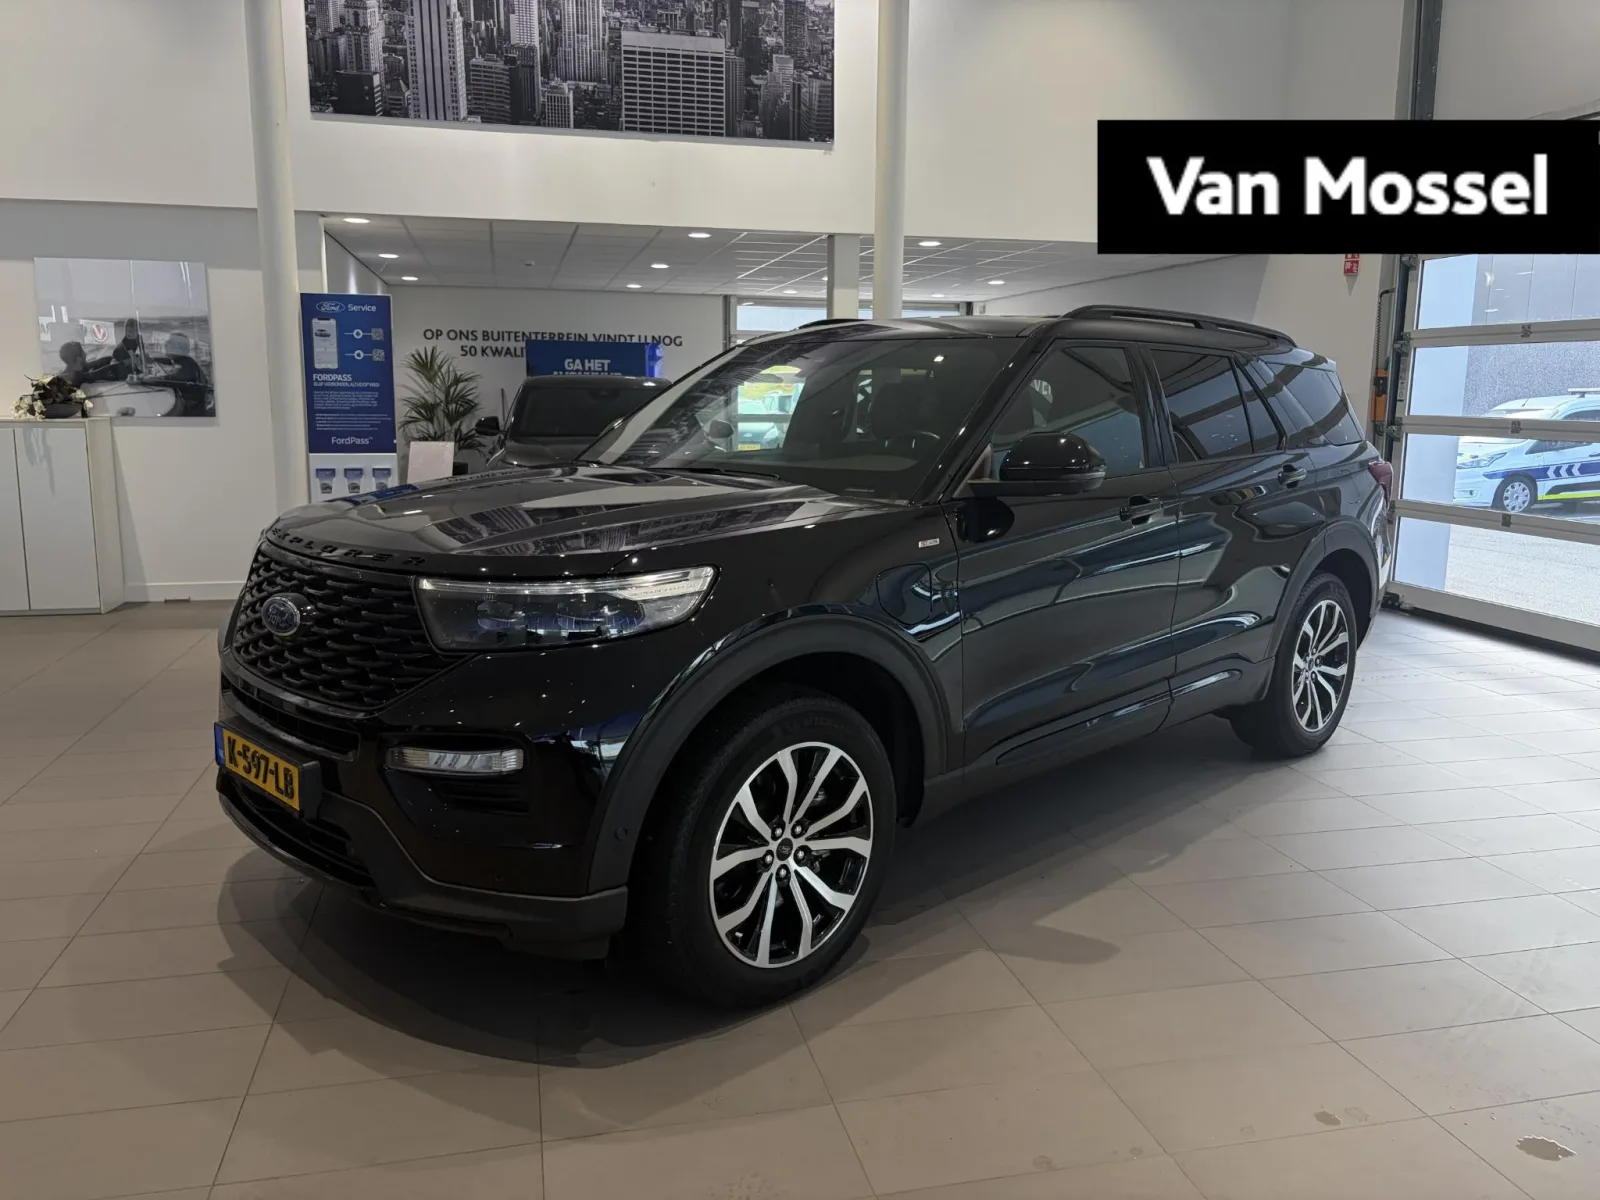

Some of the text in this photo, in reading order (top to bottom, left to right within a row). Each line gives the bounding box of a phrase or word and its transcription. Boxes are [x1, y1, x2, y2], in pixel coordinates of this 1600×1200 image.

[347, 303, 377, 312] Service
[423, 328, 443, 340] OP
[446, 329, 478, 341] ONS
[650, 335, 683, 347] NOG
[460, 345, 526, 358] 50 KWALI
[564, 358, 611, 371] GA HET
[312, 373, 352, 381] FORDPASS
[271, 527, 426, 565] EXPLORER
[227, 735, 295, 800] K-597-LB
